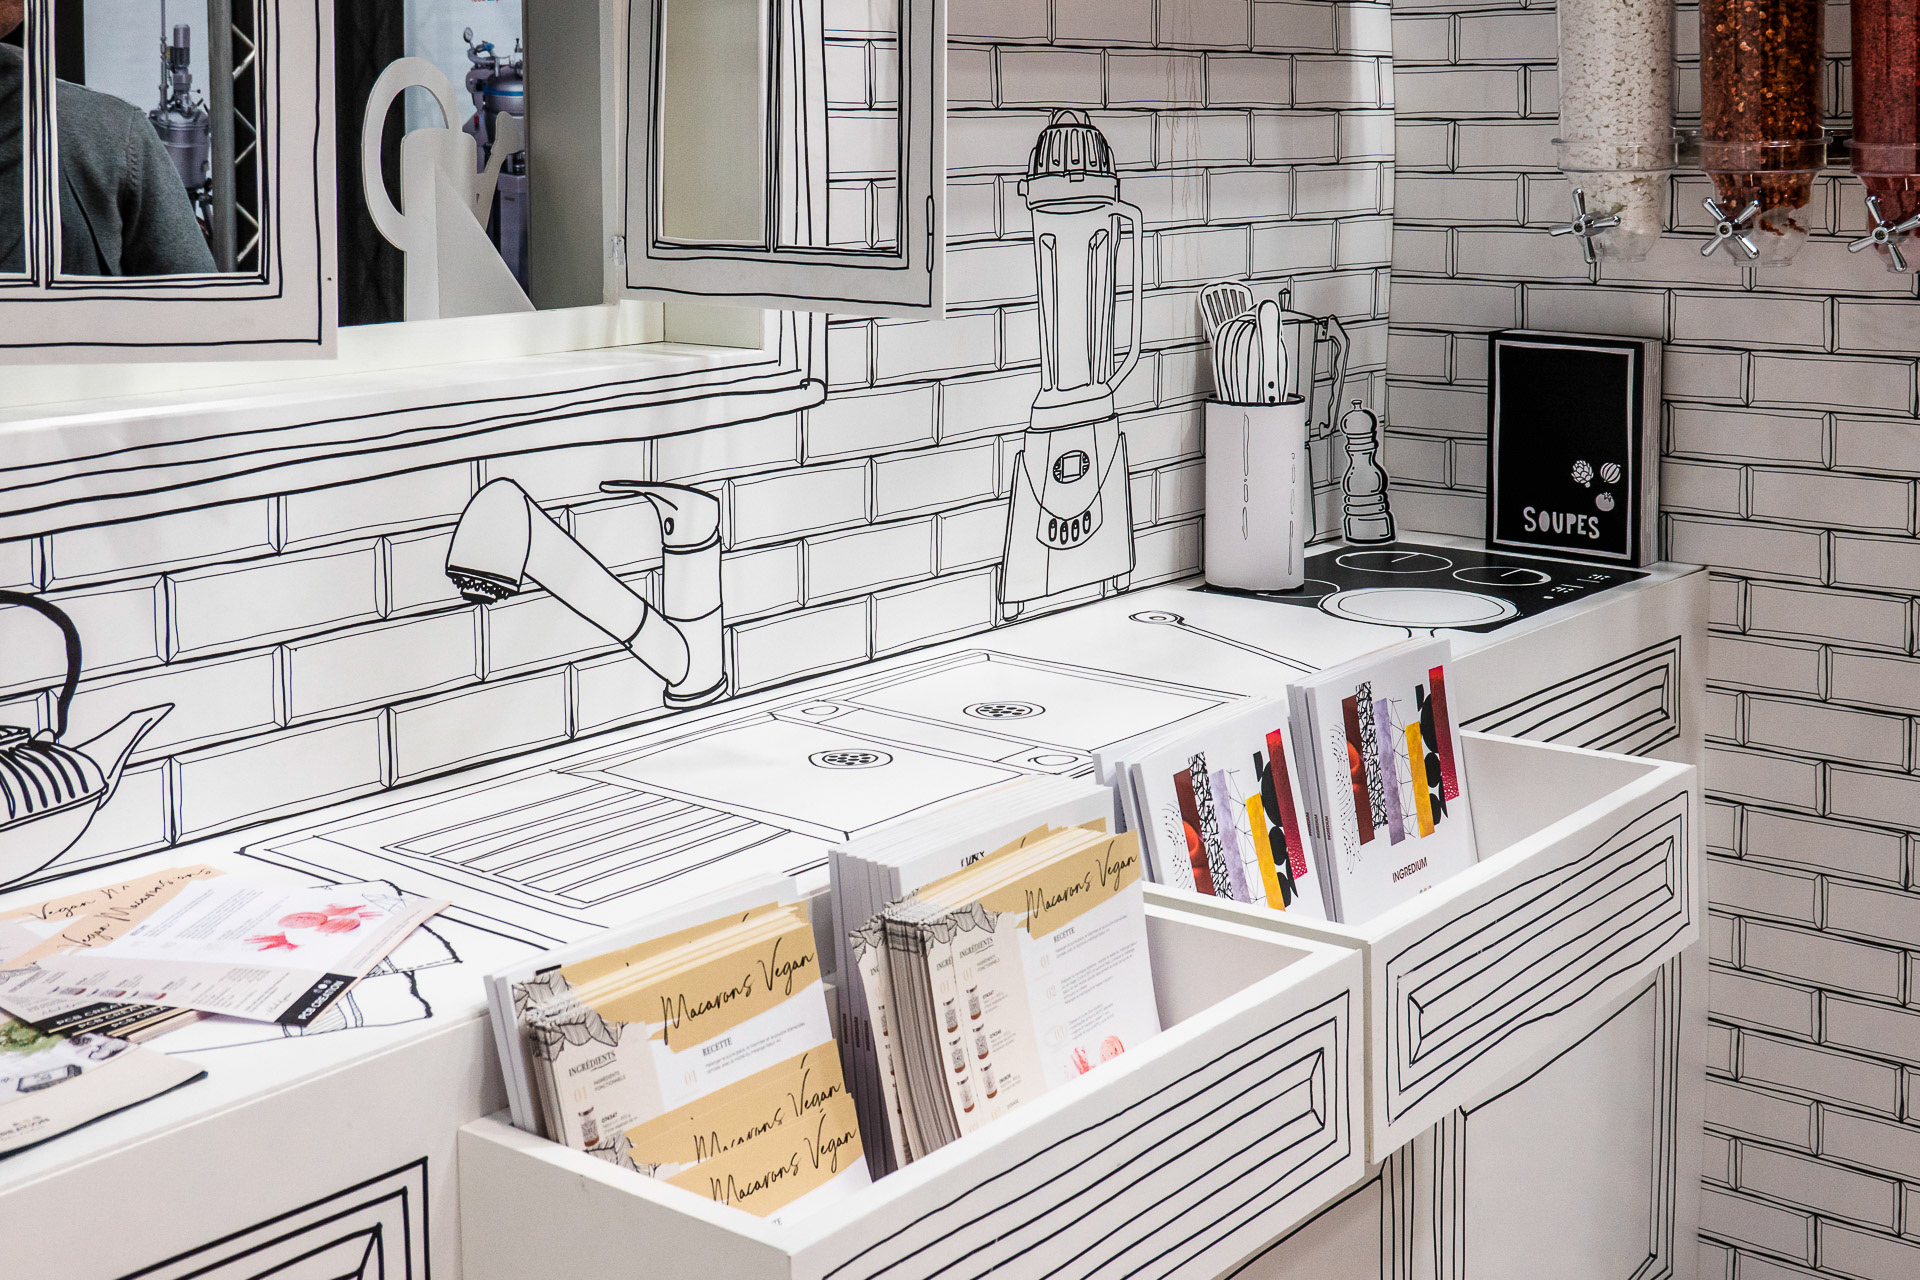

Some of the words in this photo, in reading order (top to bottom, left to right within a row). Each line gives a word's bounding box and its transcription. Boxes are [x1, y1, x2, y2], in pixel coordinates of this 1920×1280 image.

[1523, 506, 1600, 539] SOUPES
[1392, 856, 1428, 883] INGREDIUM
[1025, 871, 1091, 933] Macarons
[1095, 840, 1138, 890] Vegan
[23, 899, 96, 920] Vegan
[1053, 926, 1076, 944] RECETTE
[311, 979, 345, 1012] CREATION
[660, 974, 753, 1046] Macarons
[757, 937, 815, 996] Vegan
[702, 1037, 732, 1057] RECETTE
[568, 1050, 616, 1077] INGRÉDIENTS
[709, 1152, 802, 1206] Macarons
[804, 1113, 857, 1173] Vegan
